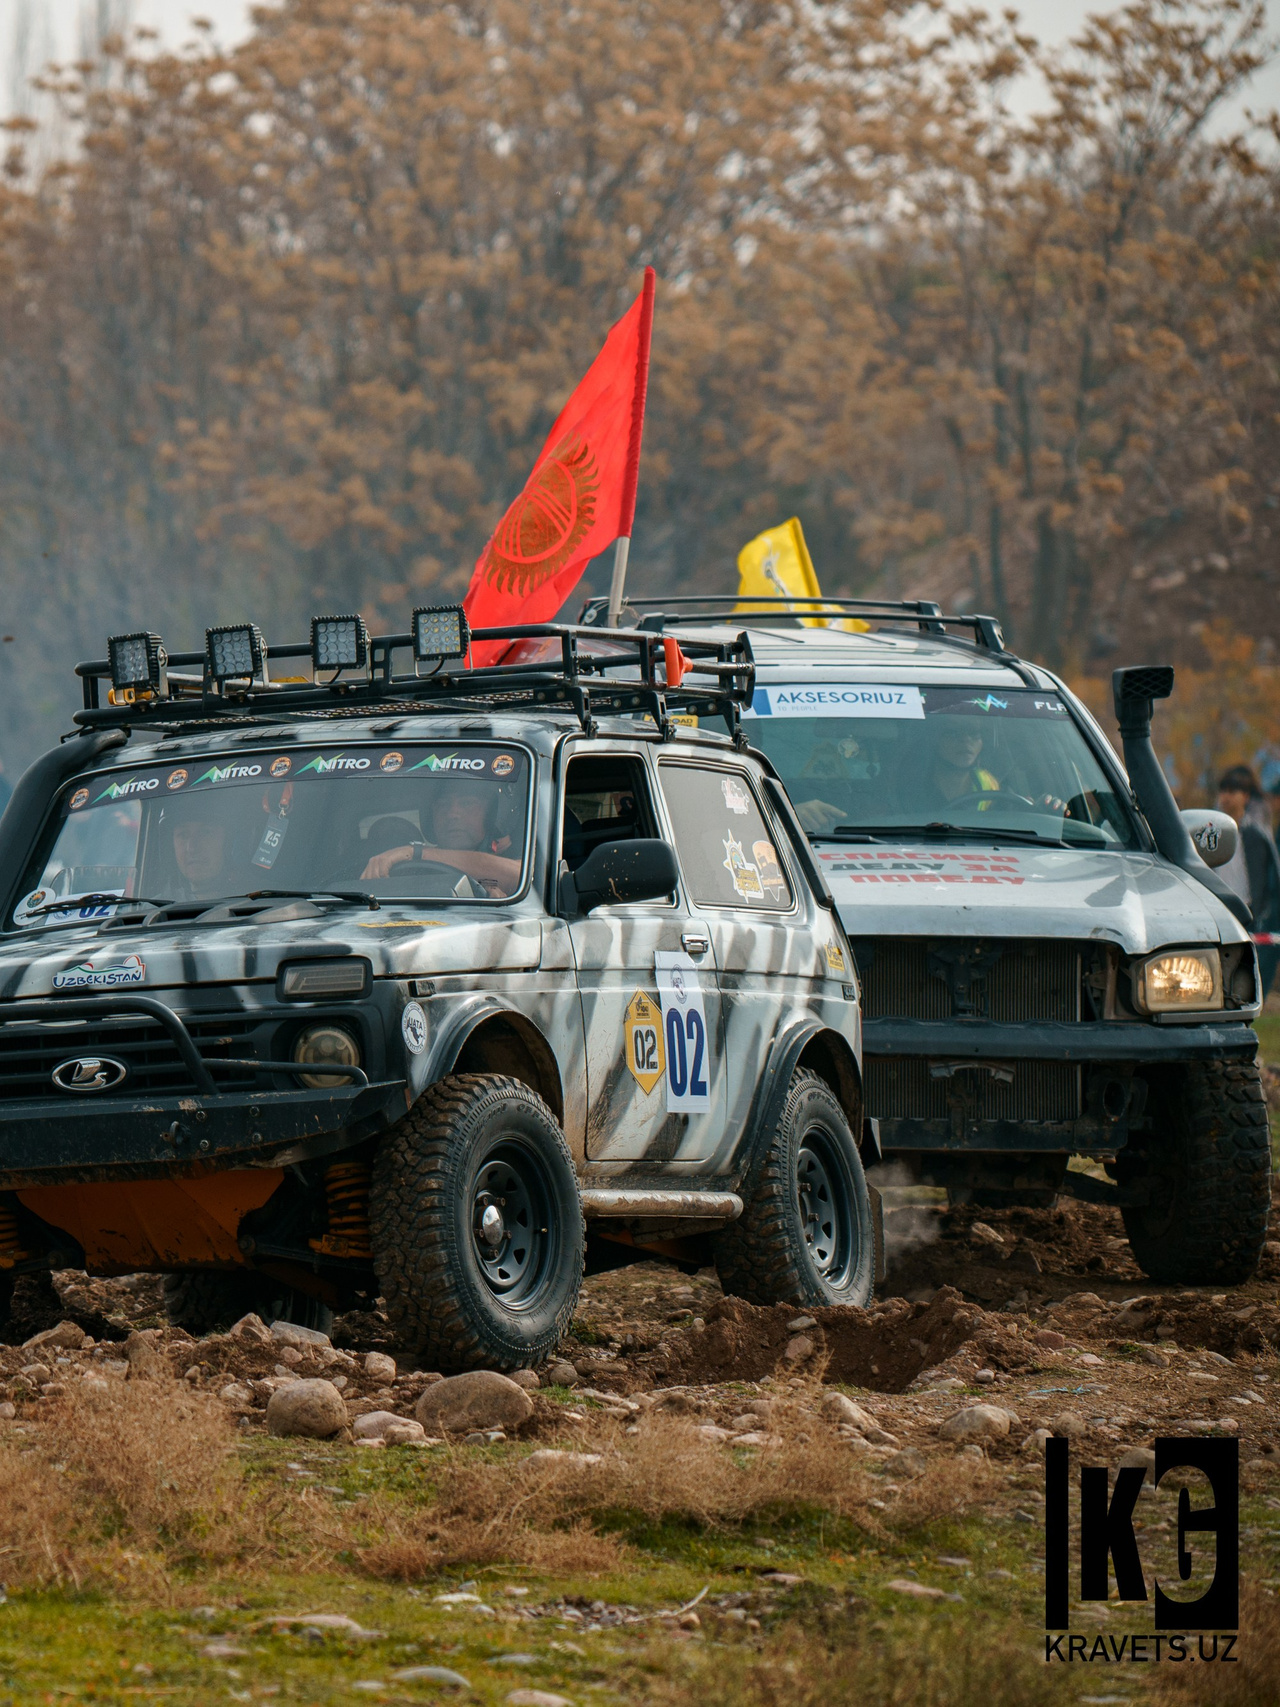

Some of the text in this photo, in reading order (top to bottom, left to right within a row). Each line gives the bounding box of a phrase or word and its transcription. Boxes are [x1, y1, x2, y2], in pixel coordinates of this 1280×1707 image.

[776, 692, 907, 705] AKSESORIUZ
[318, 758, 371, 771] NITRO
[432, 758, 485, 771] NITRO
[213, 764, 262, 781] NITRO
[112, 778, 159, 797] NITRO
[817, 852, 1020, 863] СПАСИБО
[829, 863, 1019, 873] ДЕДУ ЗА
[849, 874, 1025, 885] ПОБЕДУ
[53, 971, 142, 988] UZBEKISTAN
[634, 1029, 657, 1070] 02
[666, 1007, 708, 1097] 02
